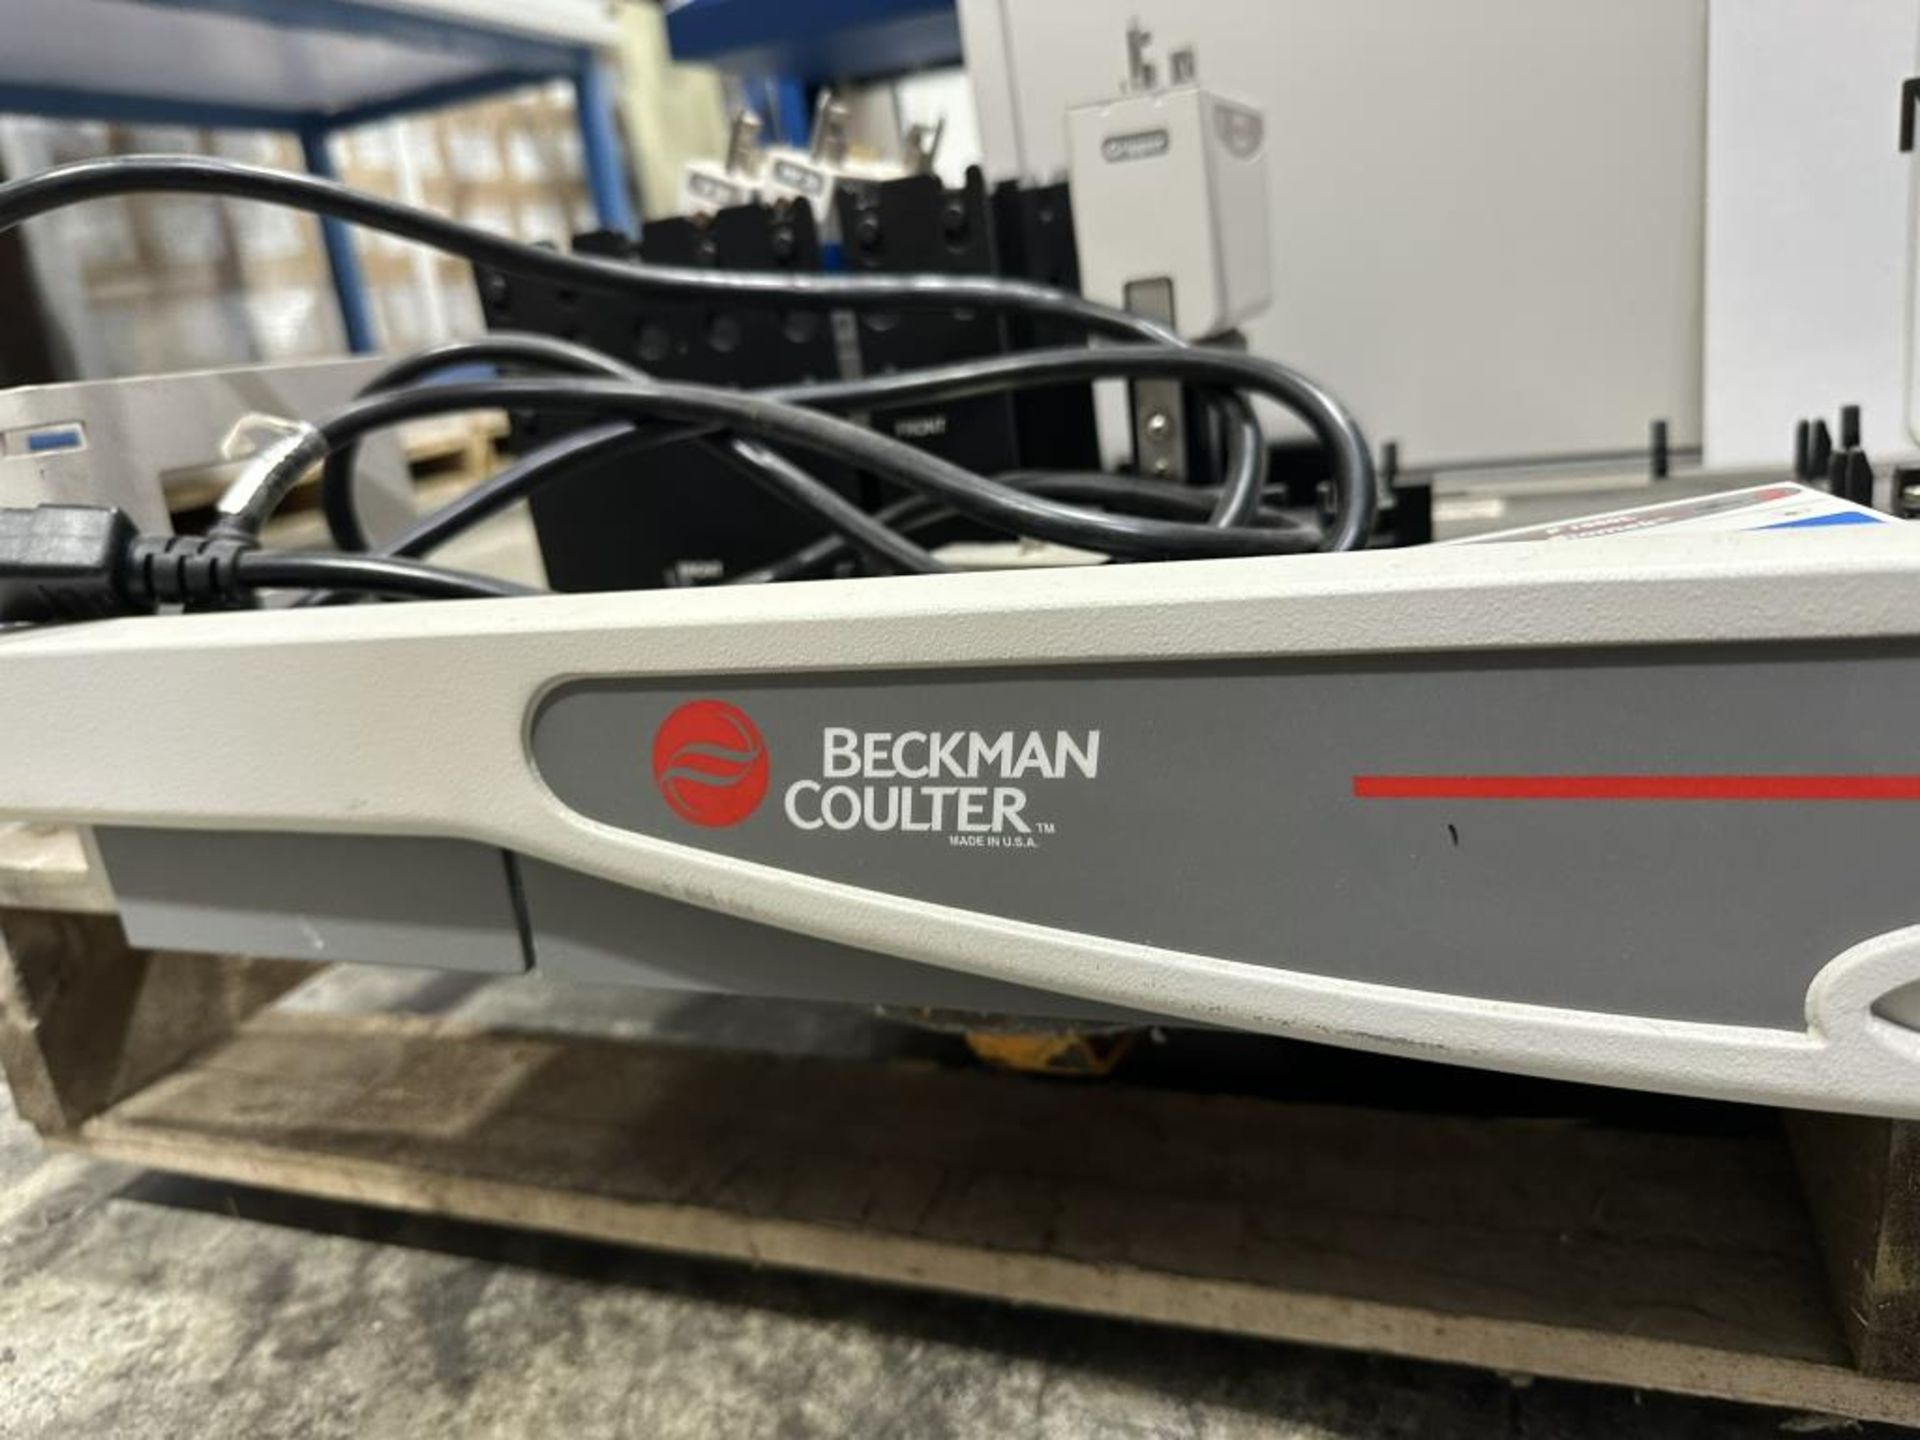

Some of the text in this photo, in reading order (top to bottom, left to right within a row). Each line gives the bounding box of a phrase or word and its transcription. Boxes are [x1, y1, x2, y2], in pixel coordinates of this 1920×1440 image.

[823, 727, 1100, 779] BECKMAN
[784, 779, 1031, 833] COULTER
[949, 835, 985, 848] MADE
[987, 836, 1000, 848] IN
